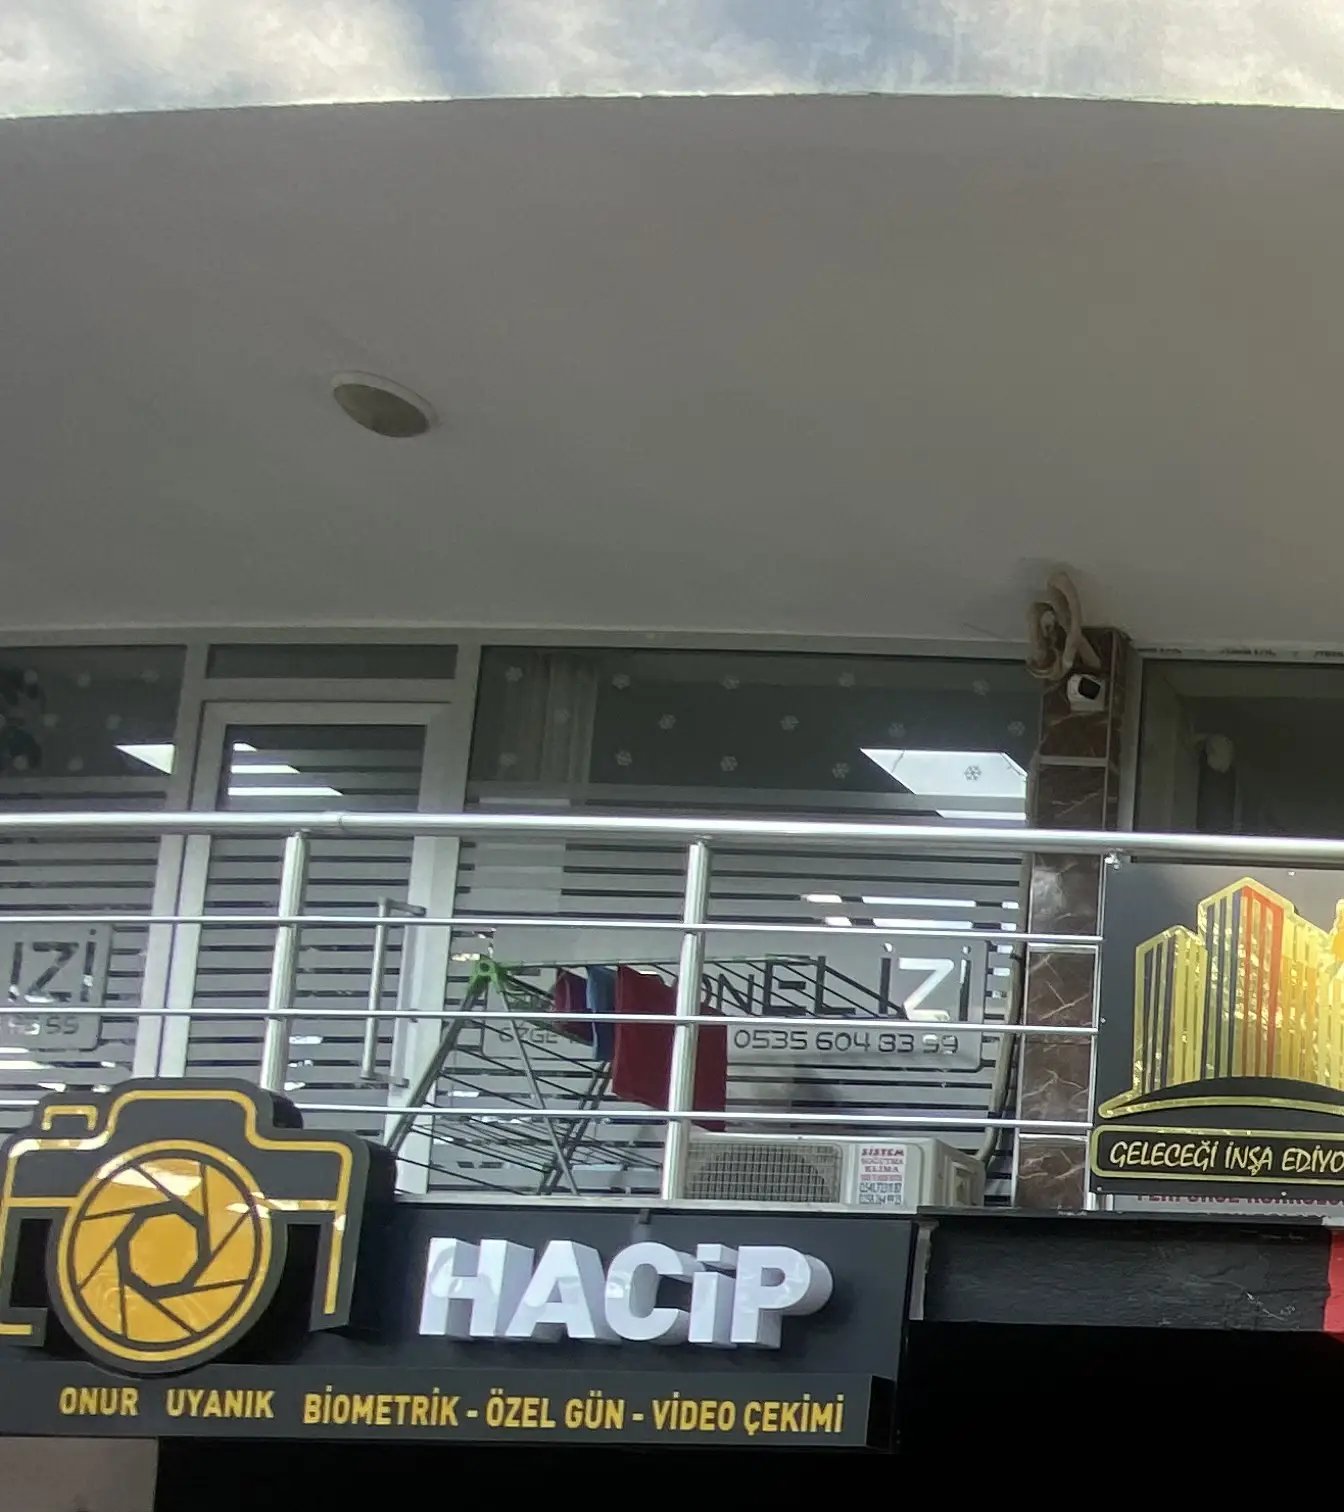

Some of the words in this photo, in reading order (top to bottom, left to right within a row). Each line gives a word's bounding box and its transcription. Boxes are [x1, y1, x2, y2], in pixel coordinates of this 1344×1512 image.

[734, 1029, 808, 1050] 0535
[815, 1031, 870, 1051] 604
[1109, 1139, 1217, 1170] GELECEĞİ
[60, 1387, 139, 1418] ONUR
[166, 1388, 275, 1420] UYANIK
[303, 1386, 459, 1429] BİOMETRİK
[486, 1390, 558, 1431] ÖZEL
[565, 1393, 625, 1433] GÜN
[652, 1390, 736, 1435] VİDEO
[743, 1392, 845, 1442] ÇEKİMİ
